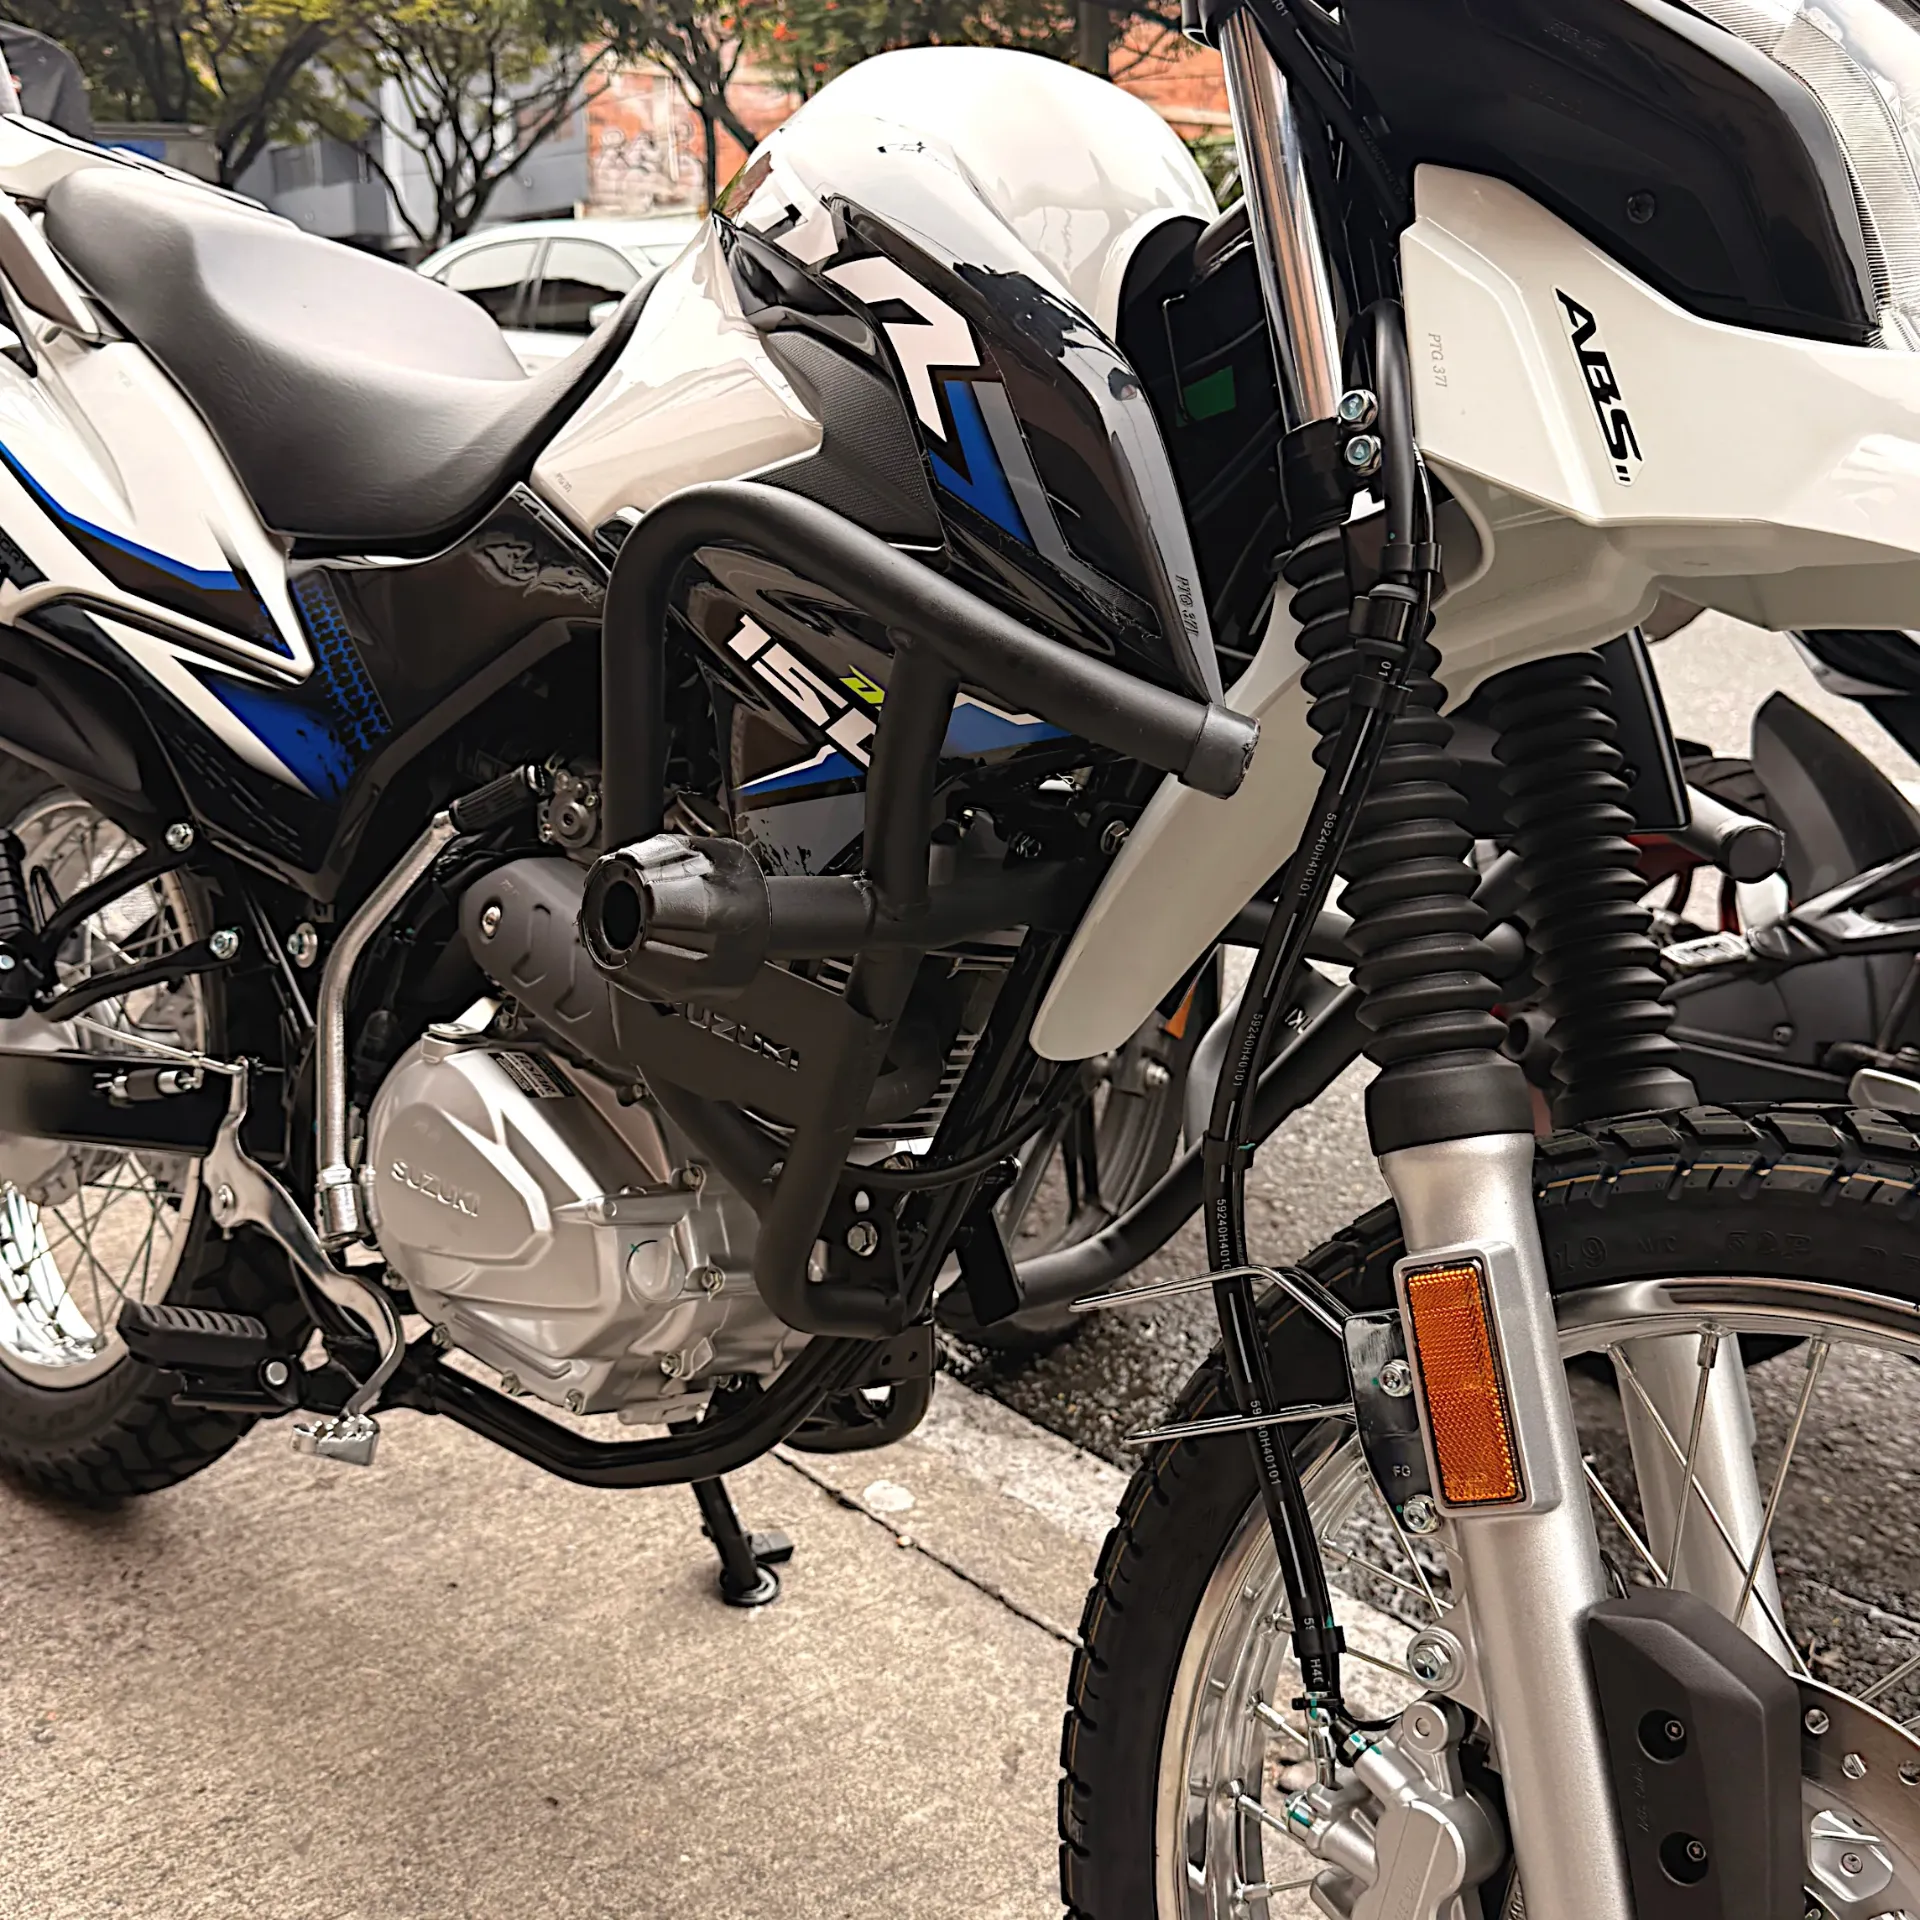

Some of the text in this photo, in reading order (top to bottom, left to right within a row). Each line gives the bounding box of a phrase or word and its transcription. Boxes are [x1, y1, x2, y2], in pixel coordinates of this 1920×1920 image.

[1555, 288, 1643, 461] ABS
[838, 663, 887, 712] D
[1297, 812, 1337, 897] 59240H40101
[1232, 1013, 1264, 1087] 59240H40101
[390, 1159, 481, 1219] SUZUKI
[1216, 1198, 1233, 1270] 59240H4010
[1250, 1400, 1282, 1485] 5940H40101
[1392, 1464, 1412, 1478] FG
